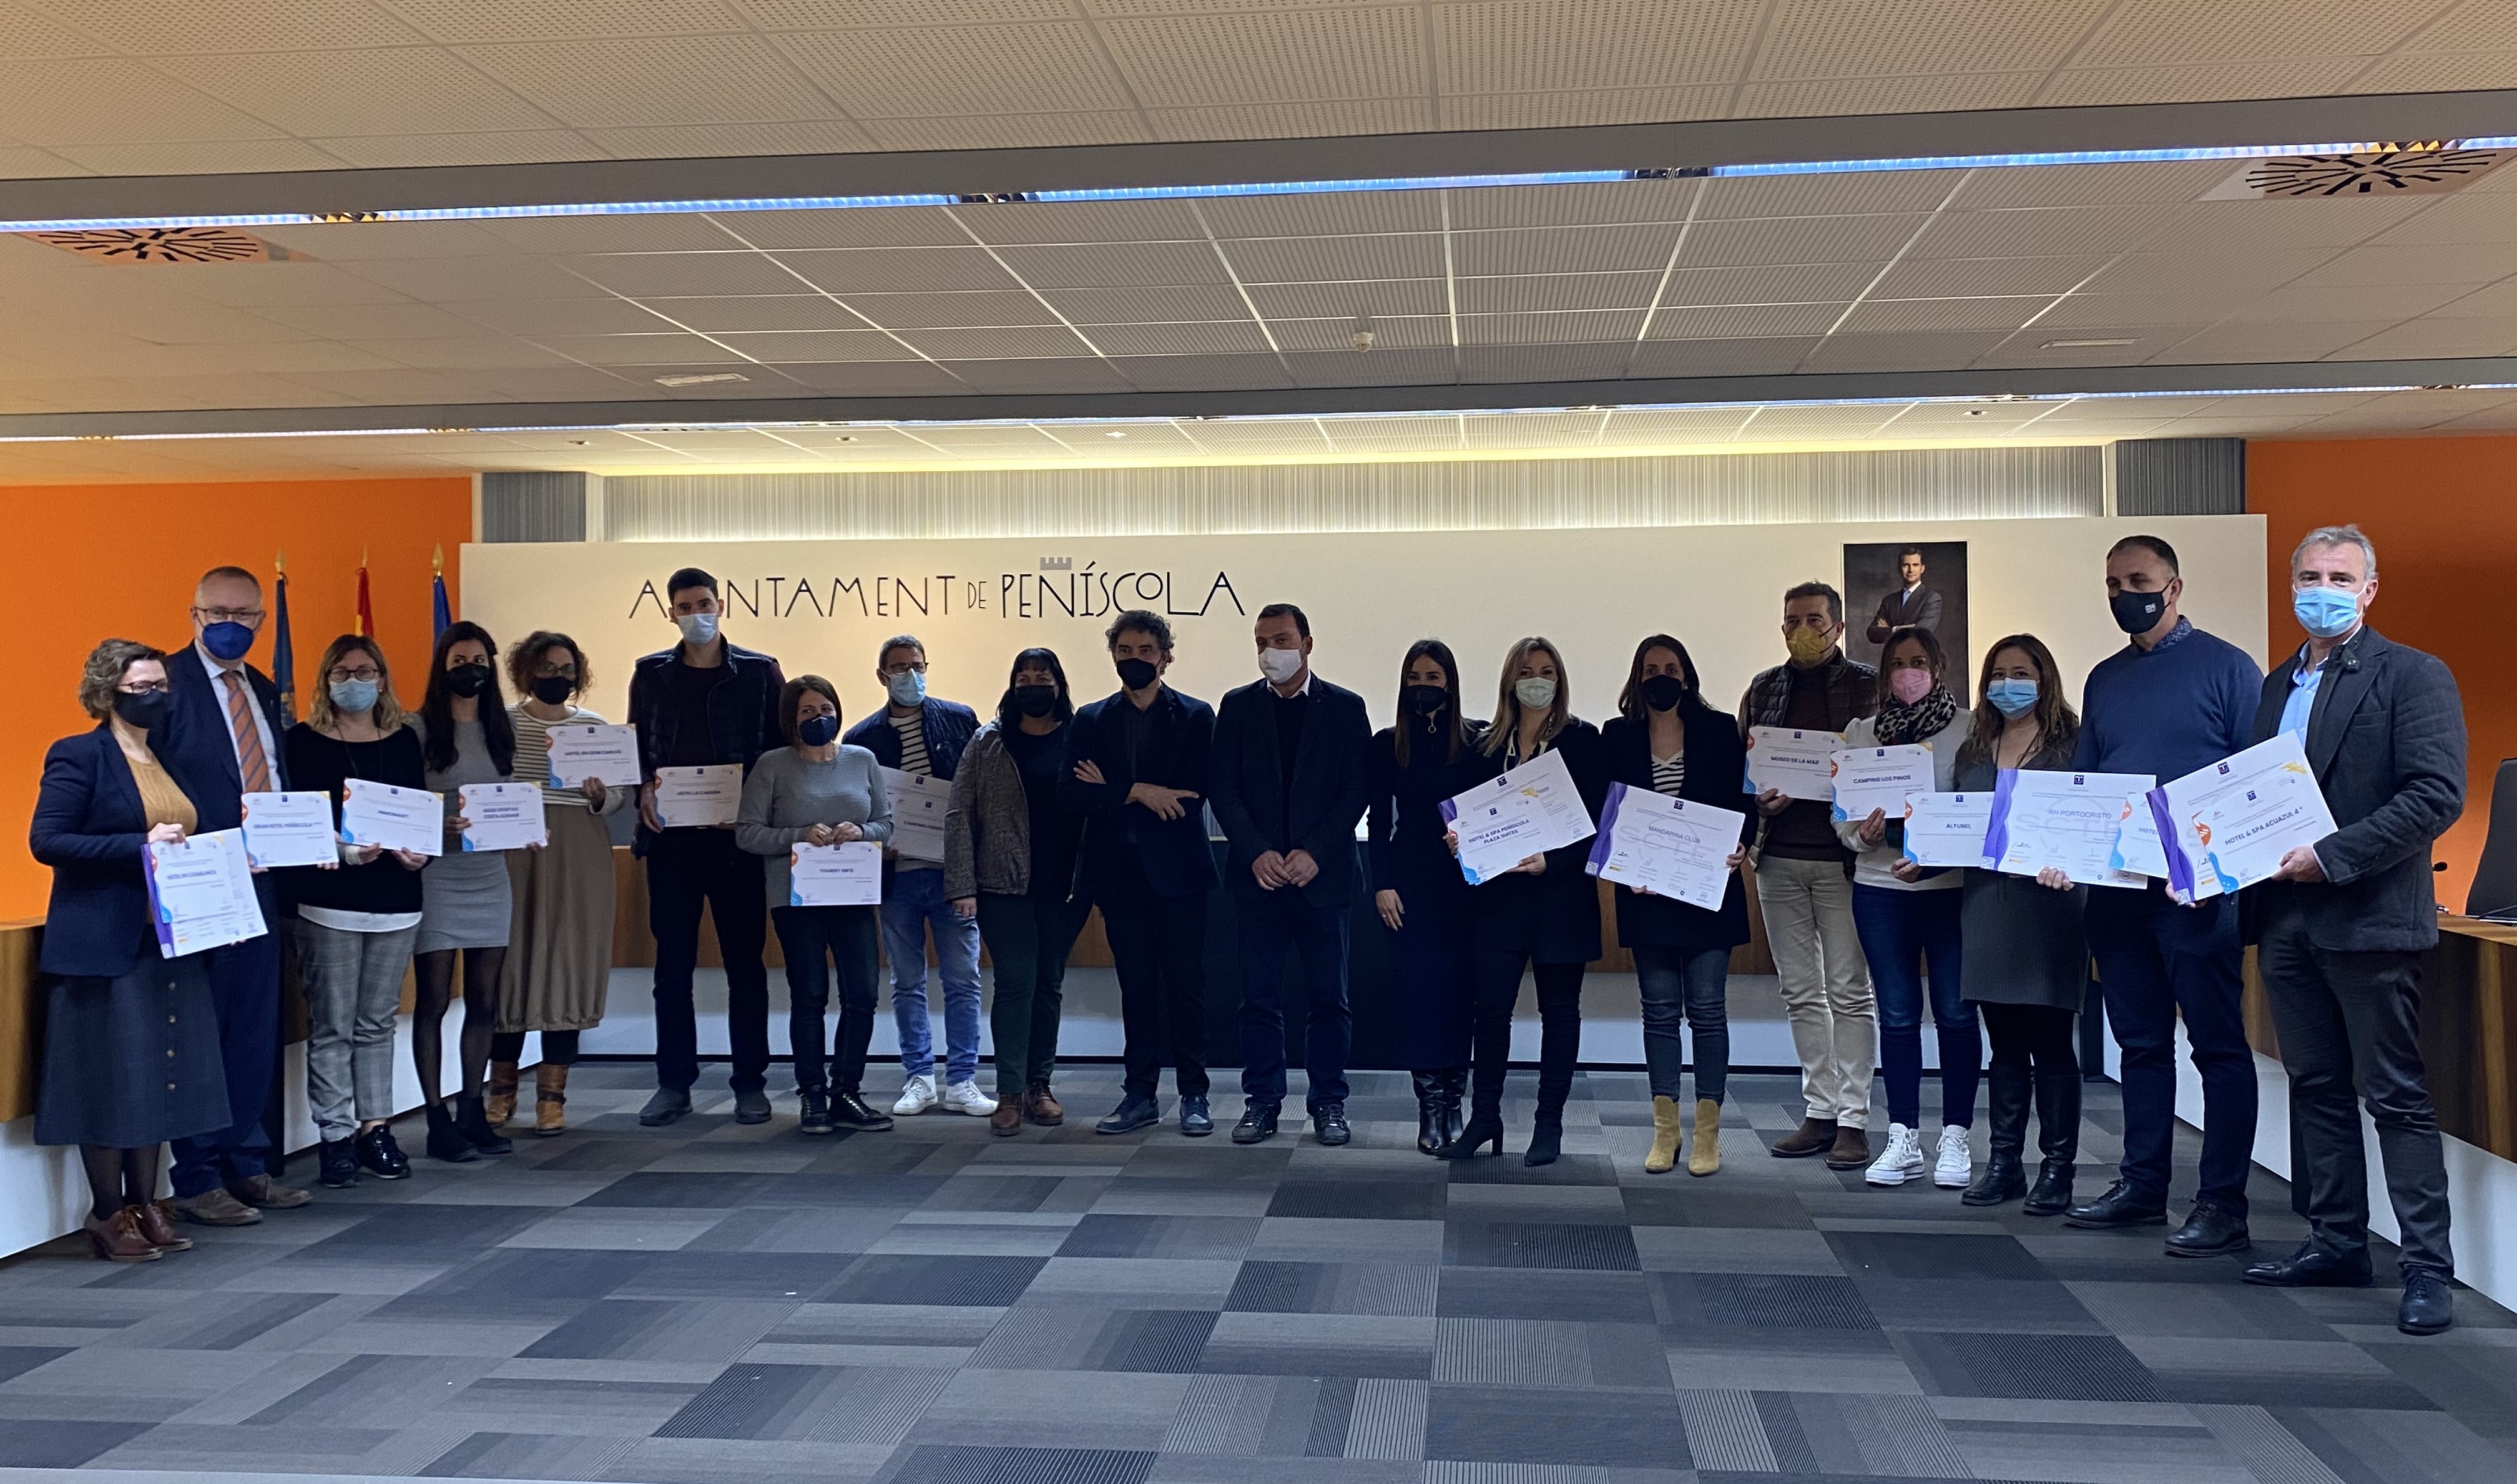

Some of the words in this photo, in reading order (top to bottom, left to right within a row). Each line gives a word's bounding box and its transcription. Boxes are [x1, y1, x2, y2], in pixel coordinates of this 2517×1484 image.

[629, 577, 956, 619] ANTAMENT
[967, 580, 987, 610] DE
[2060, 809, 2112, 819] PORTOCRISTO
[1468, 834, 1485, 843] HOTEL
[1490, 828, 1501, 836] SPA
[1648, 826, 1683, 841] MANDARINA
[1684, 834, 1701, 844] CLUB
[2225, 832, 2246, 845] HOTEL
[2252, 824, 2265, 834] SPA
[2265, 811, 2294, 828] ACUAZUL
[1484, 835, 1500, 844] PLAZA
